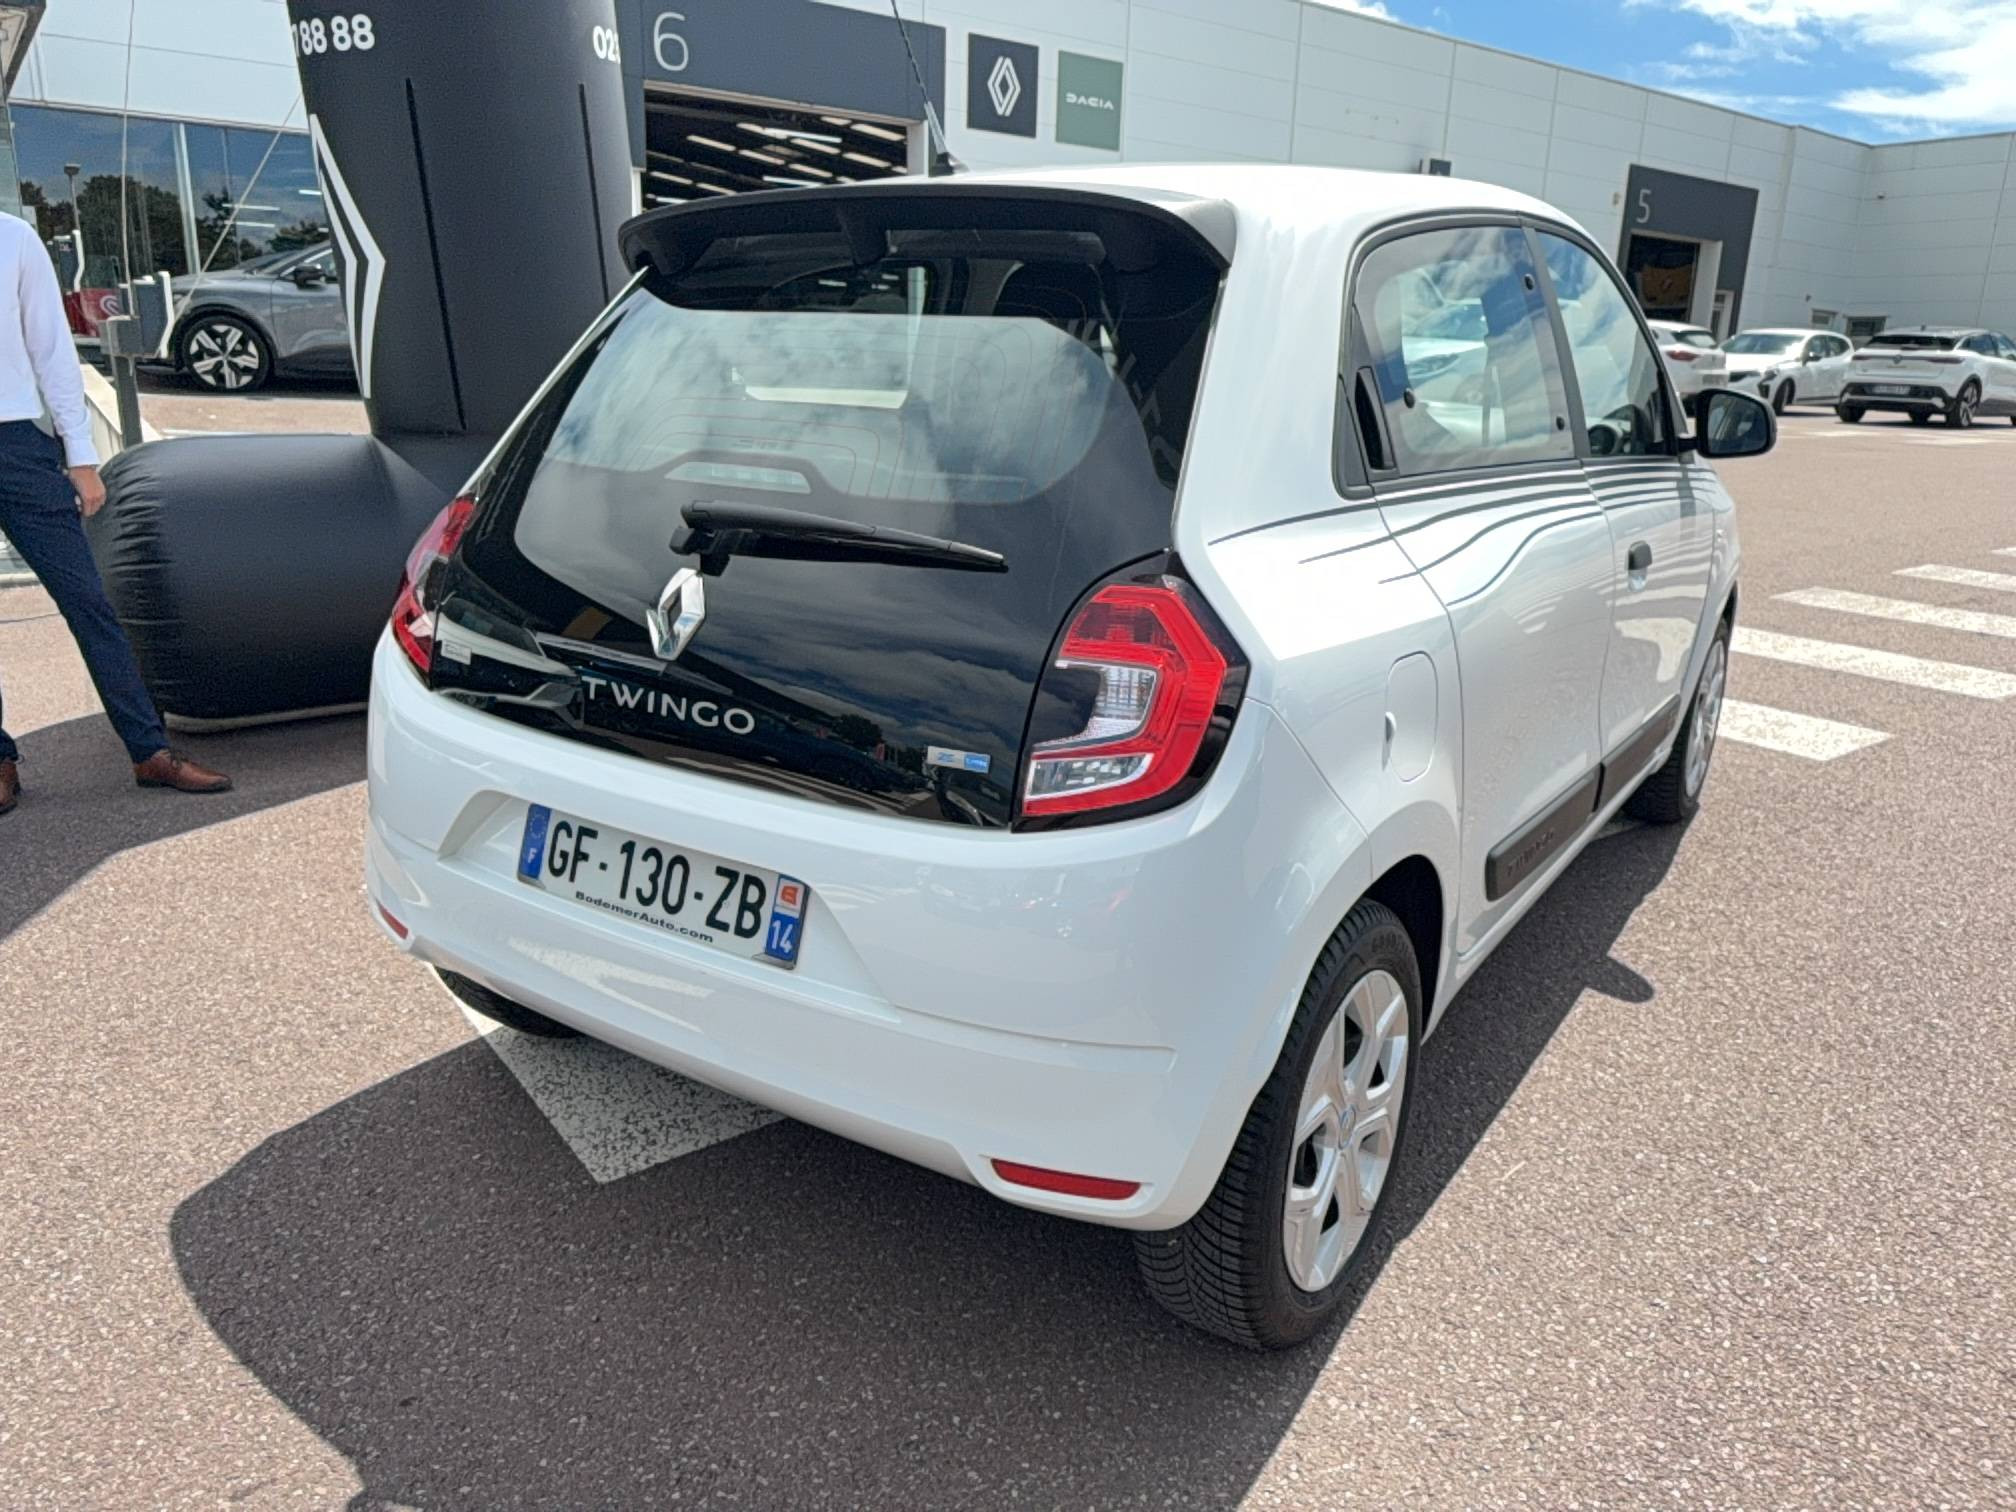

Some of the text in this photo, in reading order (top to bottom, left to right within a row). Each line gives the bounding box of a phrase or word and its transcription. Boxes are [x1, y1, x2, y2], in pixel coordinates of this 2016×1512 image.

[331, 13, 375, 50] 88
[654, 11, 689, 71] 6
[1065, 92, 1115, 110] DACIA
[1636, 189, 1652, 223] 5
[581, 675, 755, 735] TWINGO
[527, 847, 537, 864] F
[548, 820, 767, 939] GF-130-ZB
[575, 889, 715, 943] BodemerAuto.com
[771, 920, 794, 954] 14
